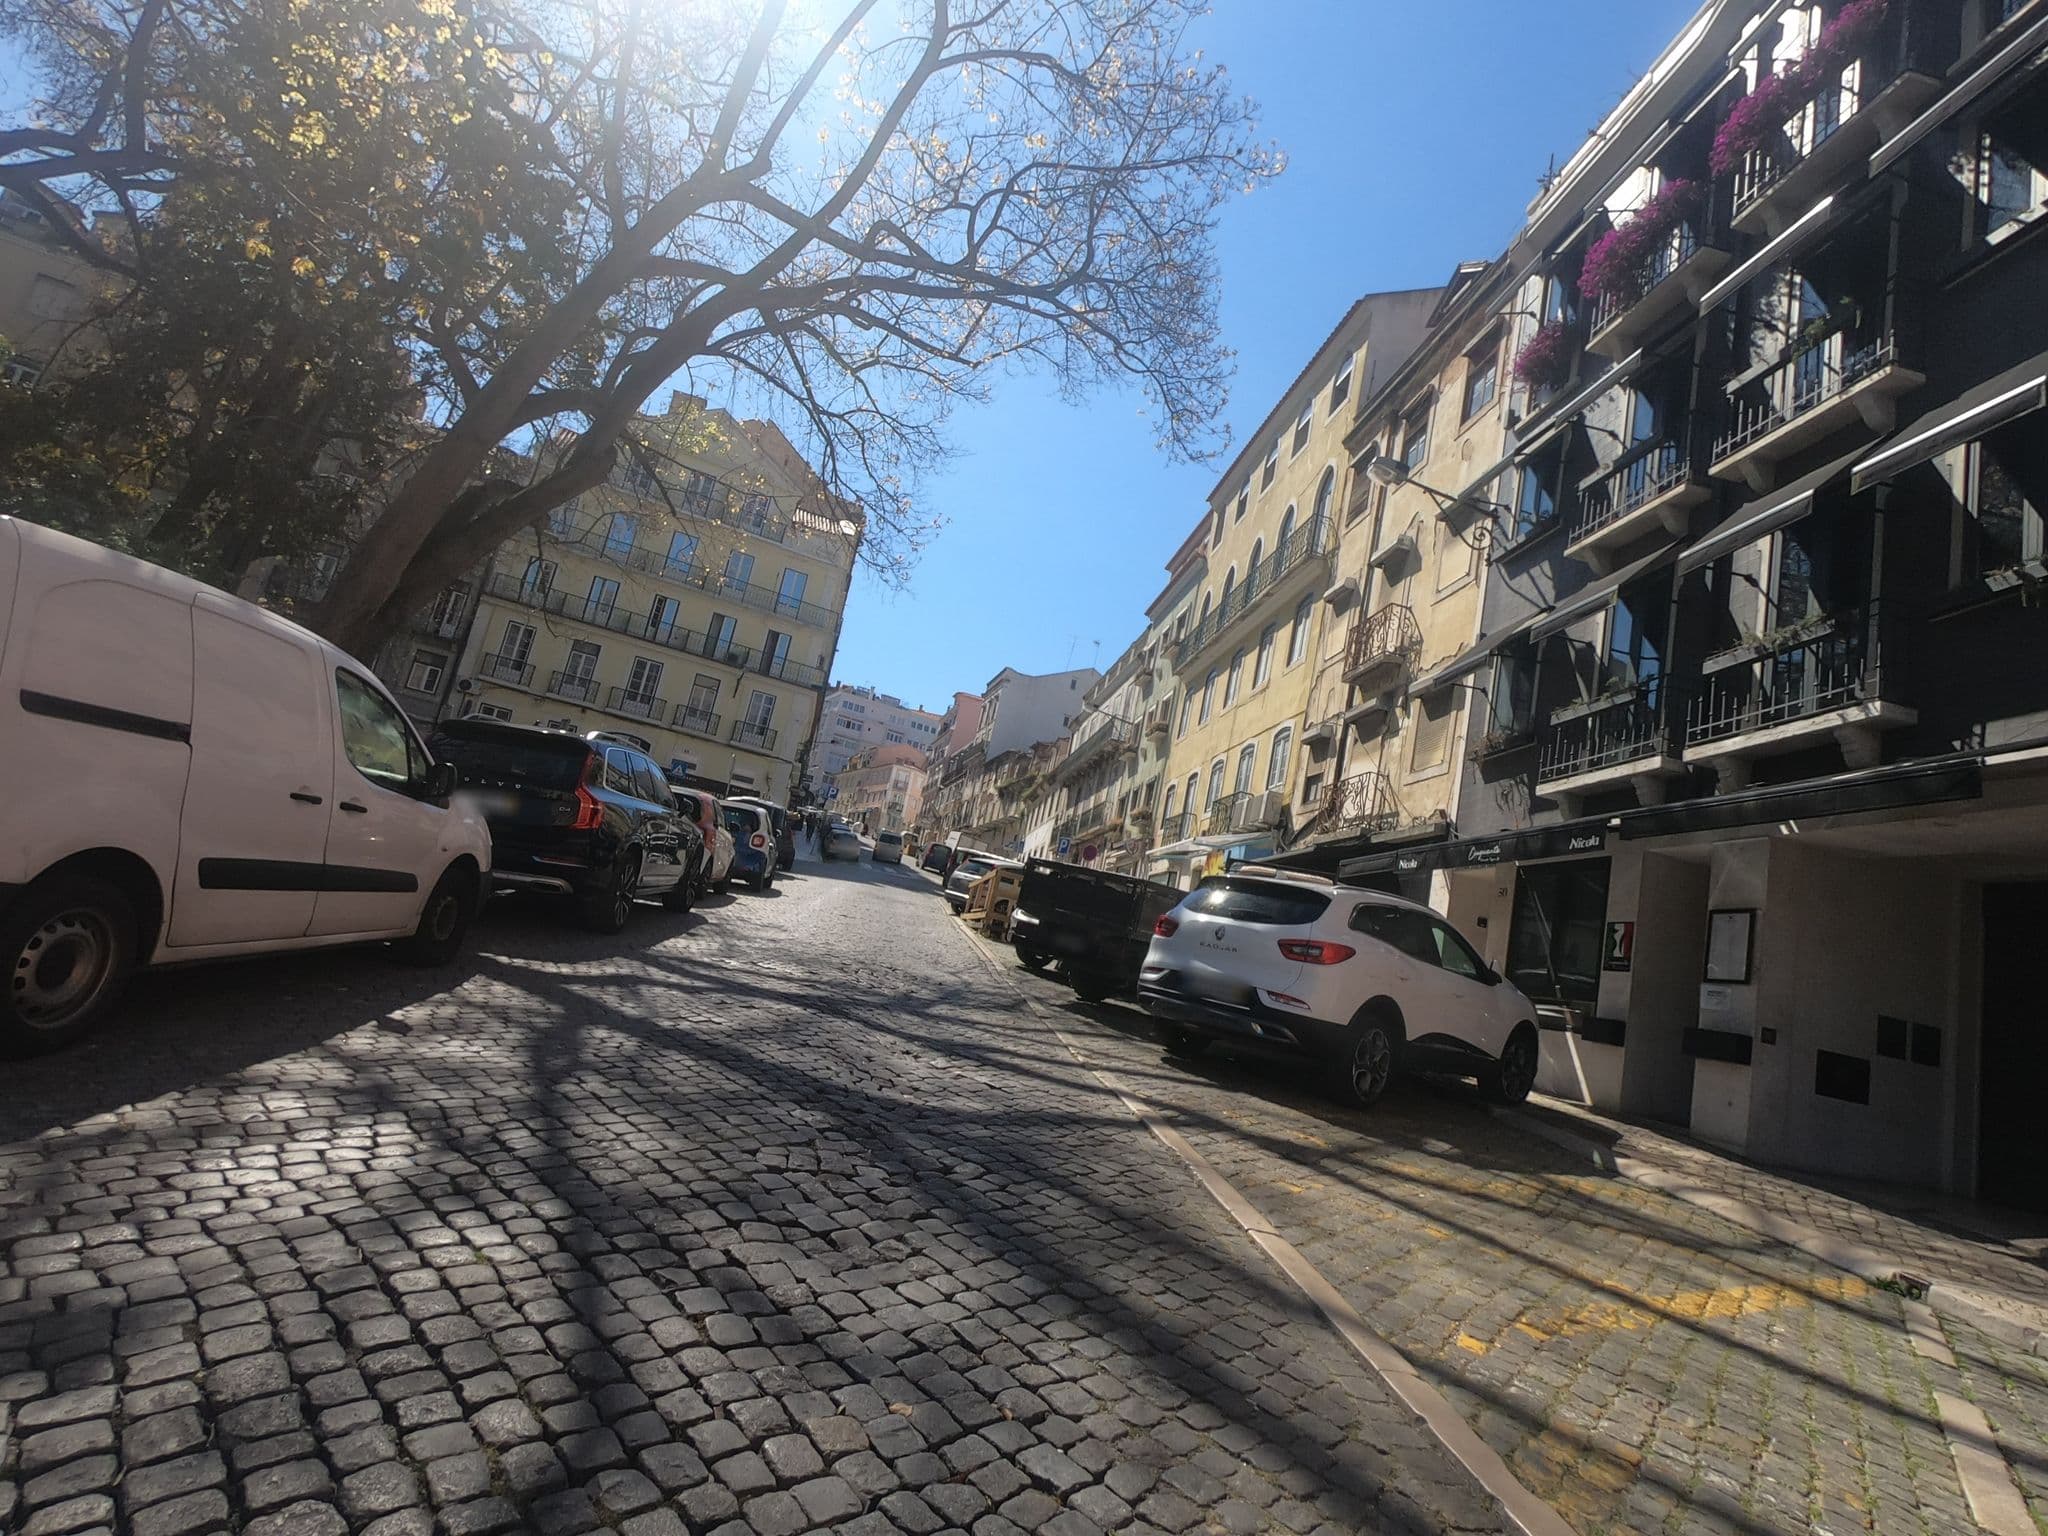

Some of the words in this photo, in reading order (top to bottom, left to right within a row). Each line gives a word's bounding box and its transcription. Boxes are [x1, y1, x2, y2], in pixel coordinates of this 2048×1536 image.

[464, 776, 521, 789] OLVO
[1059, 839, 1068, 851] P
[1568, 835, 1600, 850] Nicola
[1398, 858, 1418, 870] Nicola
